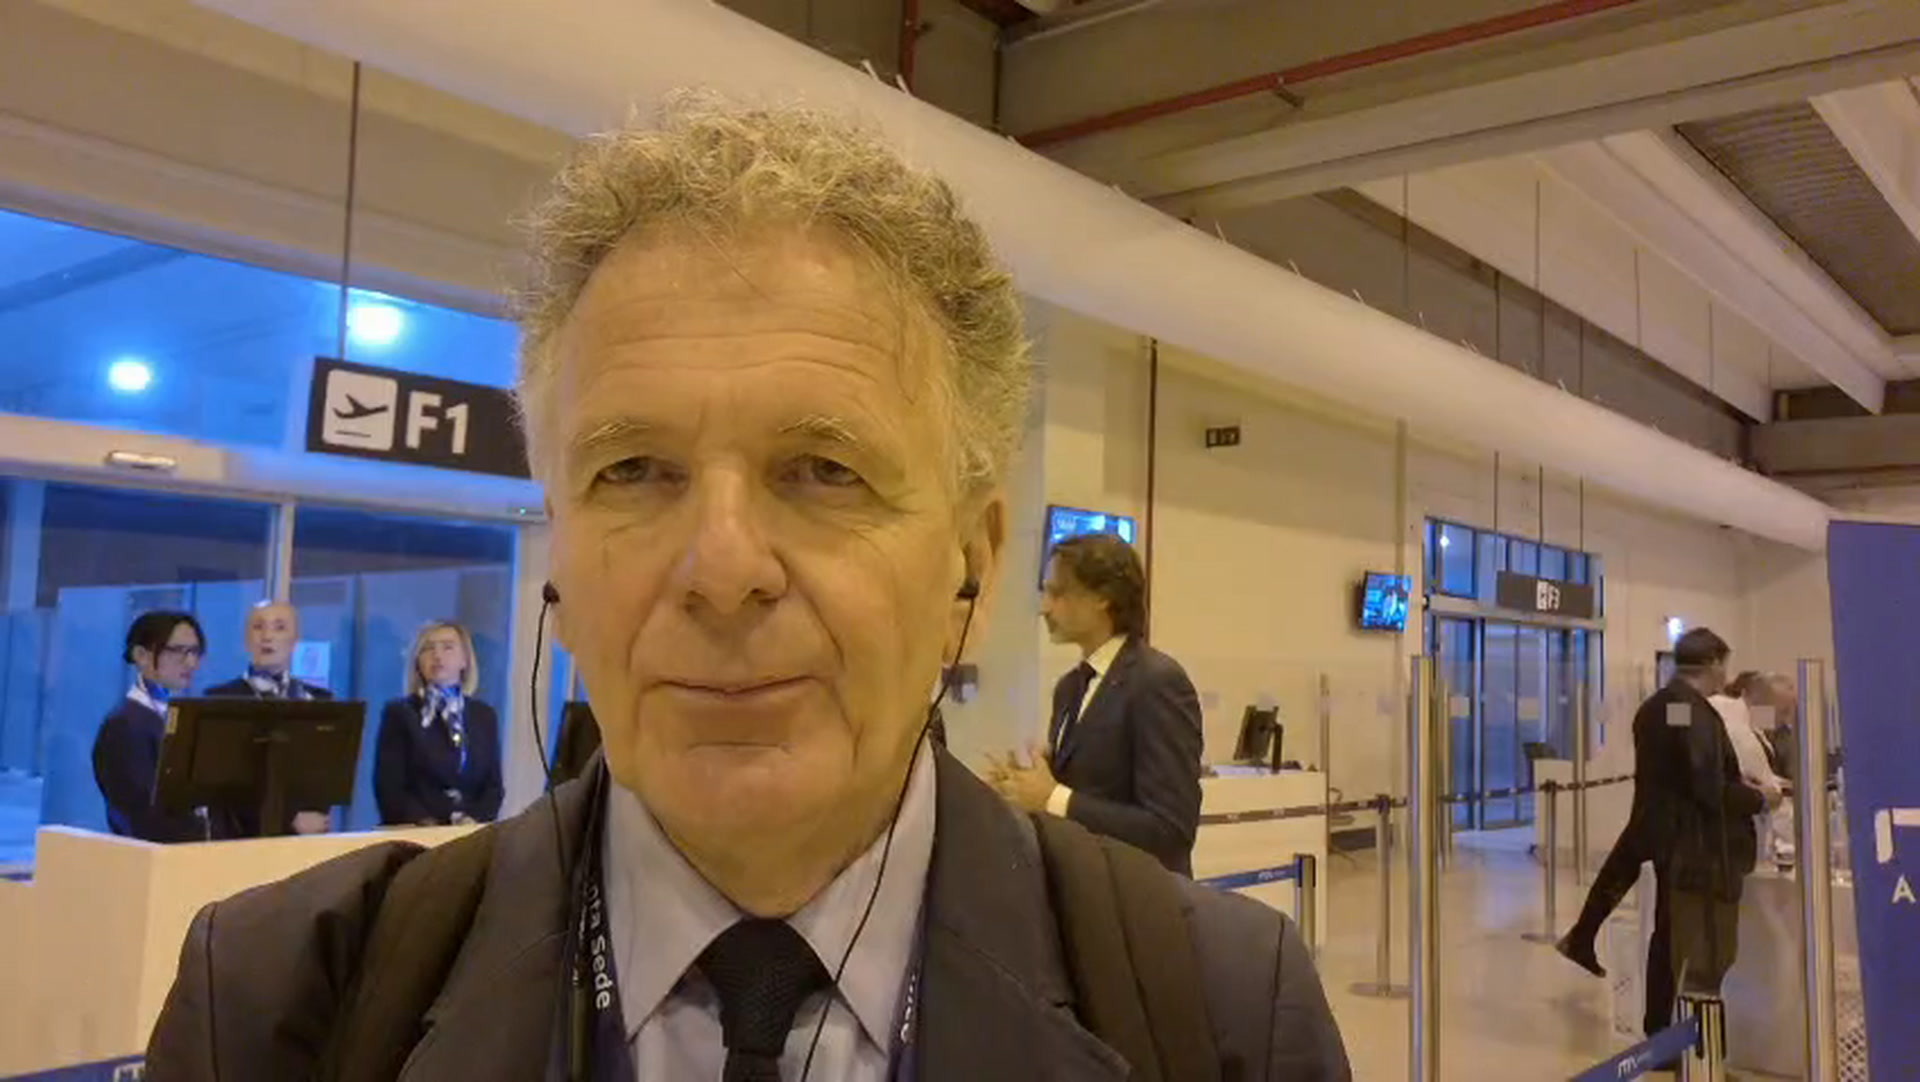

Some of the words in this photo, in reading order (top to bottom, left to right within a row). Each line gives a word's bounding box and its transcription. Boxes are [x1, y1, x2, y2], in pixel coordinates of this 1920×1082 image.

[405, 390, 469, 454] F1
[586, 883, 602, 930] nta
[591, 934, 613, 1010] Sede
